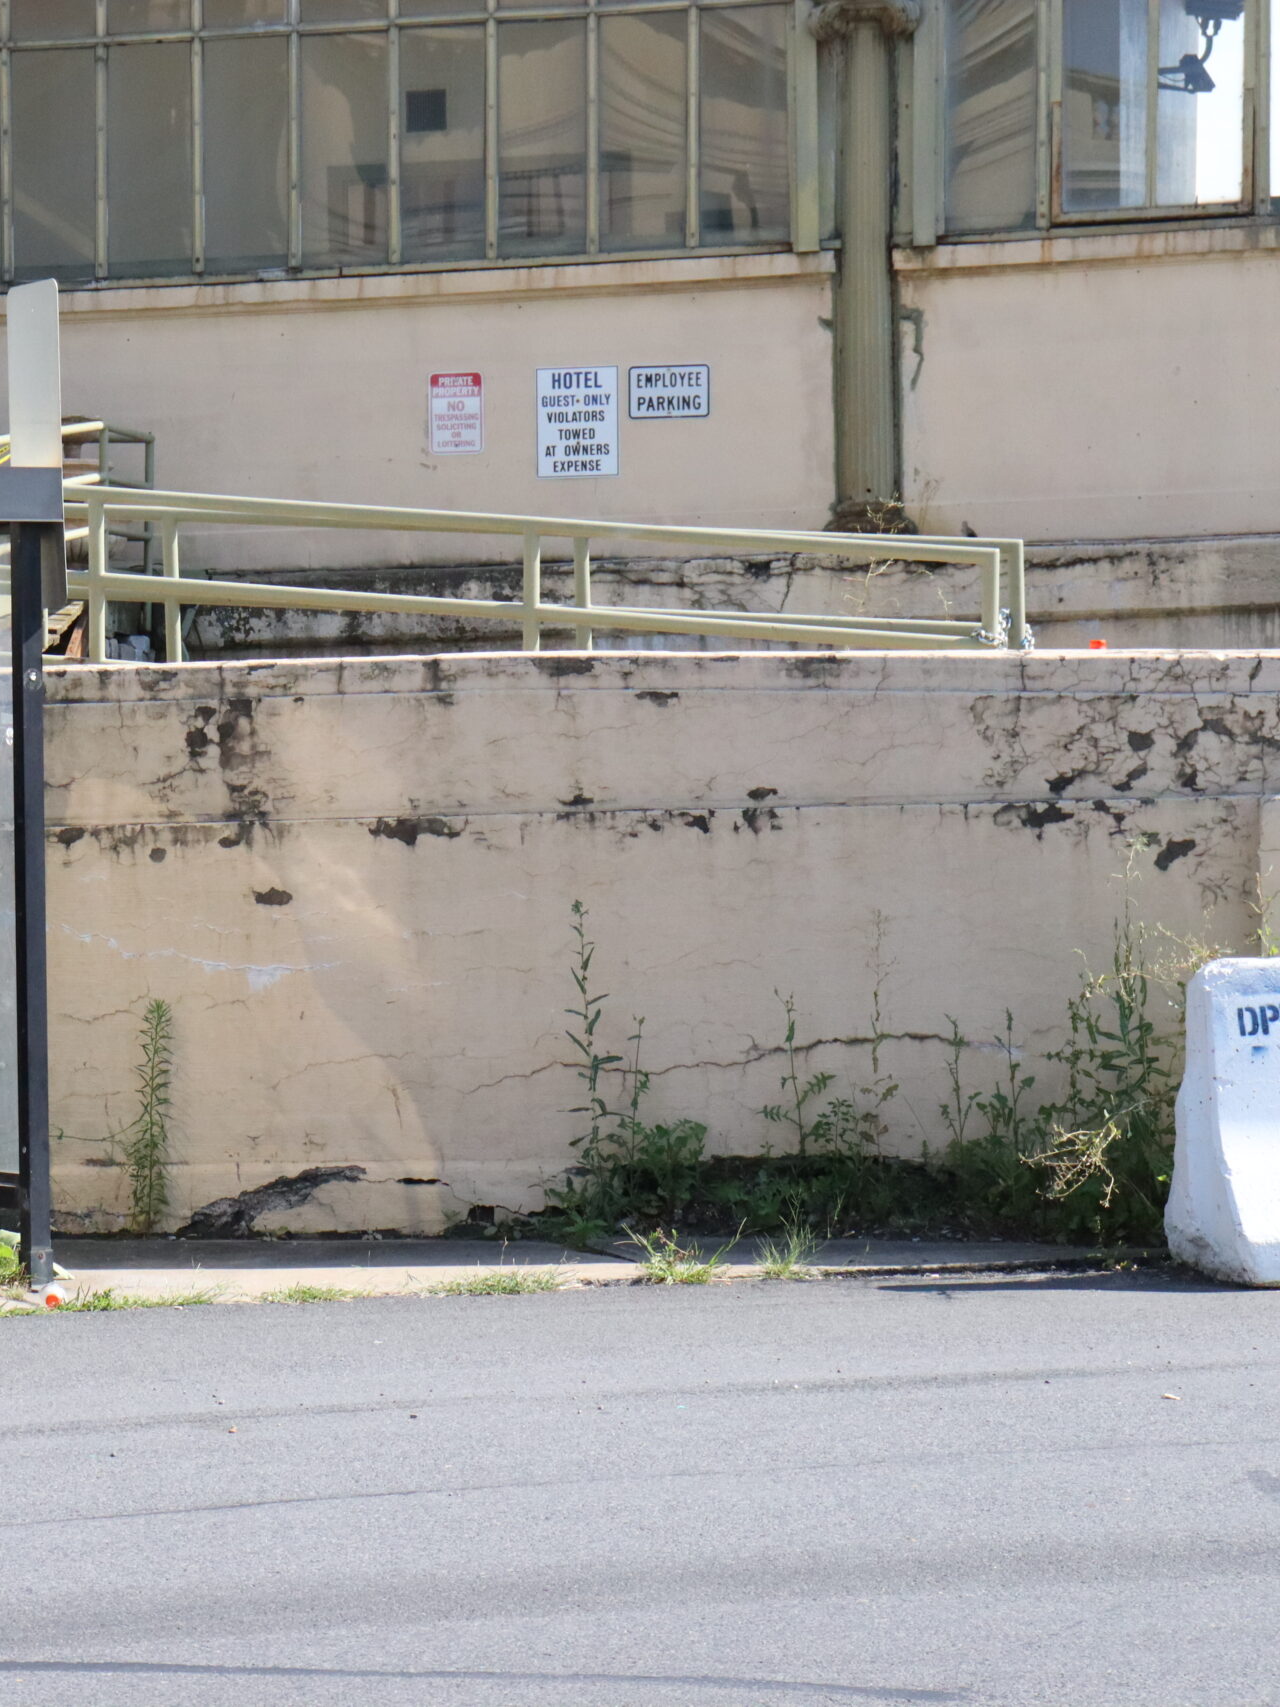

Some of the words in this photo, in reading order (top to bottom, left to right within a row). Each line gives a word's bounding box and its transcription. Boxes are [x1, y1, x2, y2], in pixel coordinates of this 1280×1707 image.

[439, 376, 473, 386] PRIVATE
[552, 371, 603, 389] HOTEL
[636, 371, 702, 389] EMPLOYEE
[432, 386, 480, 397] PROPERTY
[447, 400, 465, 412] NO
[541, 394, 576, 408] GUEST
[583, 393, 611, 406] ONLY
[637, 395, 702, 411] PARKING
[434, 413, 480, 422] TRESPASSING
[546, 410, 605, 424] VIOLATORS
[436, 422, 477, 431] SOLICITING
[558, 428, 596, 441] TOWED
[437, 440, 476, 448] LOITERING
[545, 445, 557, 457] AT
[564, 443, 610, 456] OWNERS
[553, 459, 602, 473] EXPENSE
